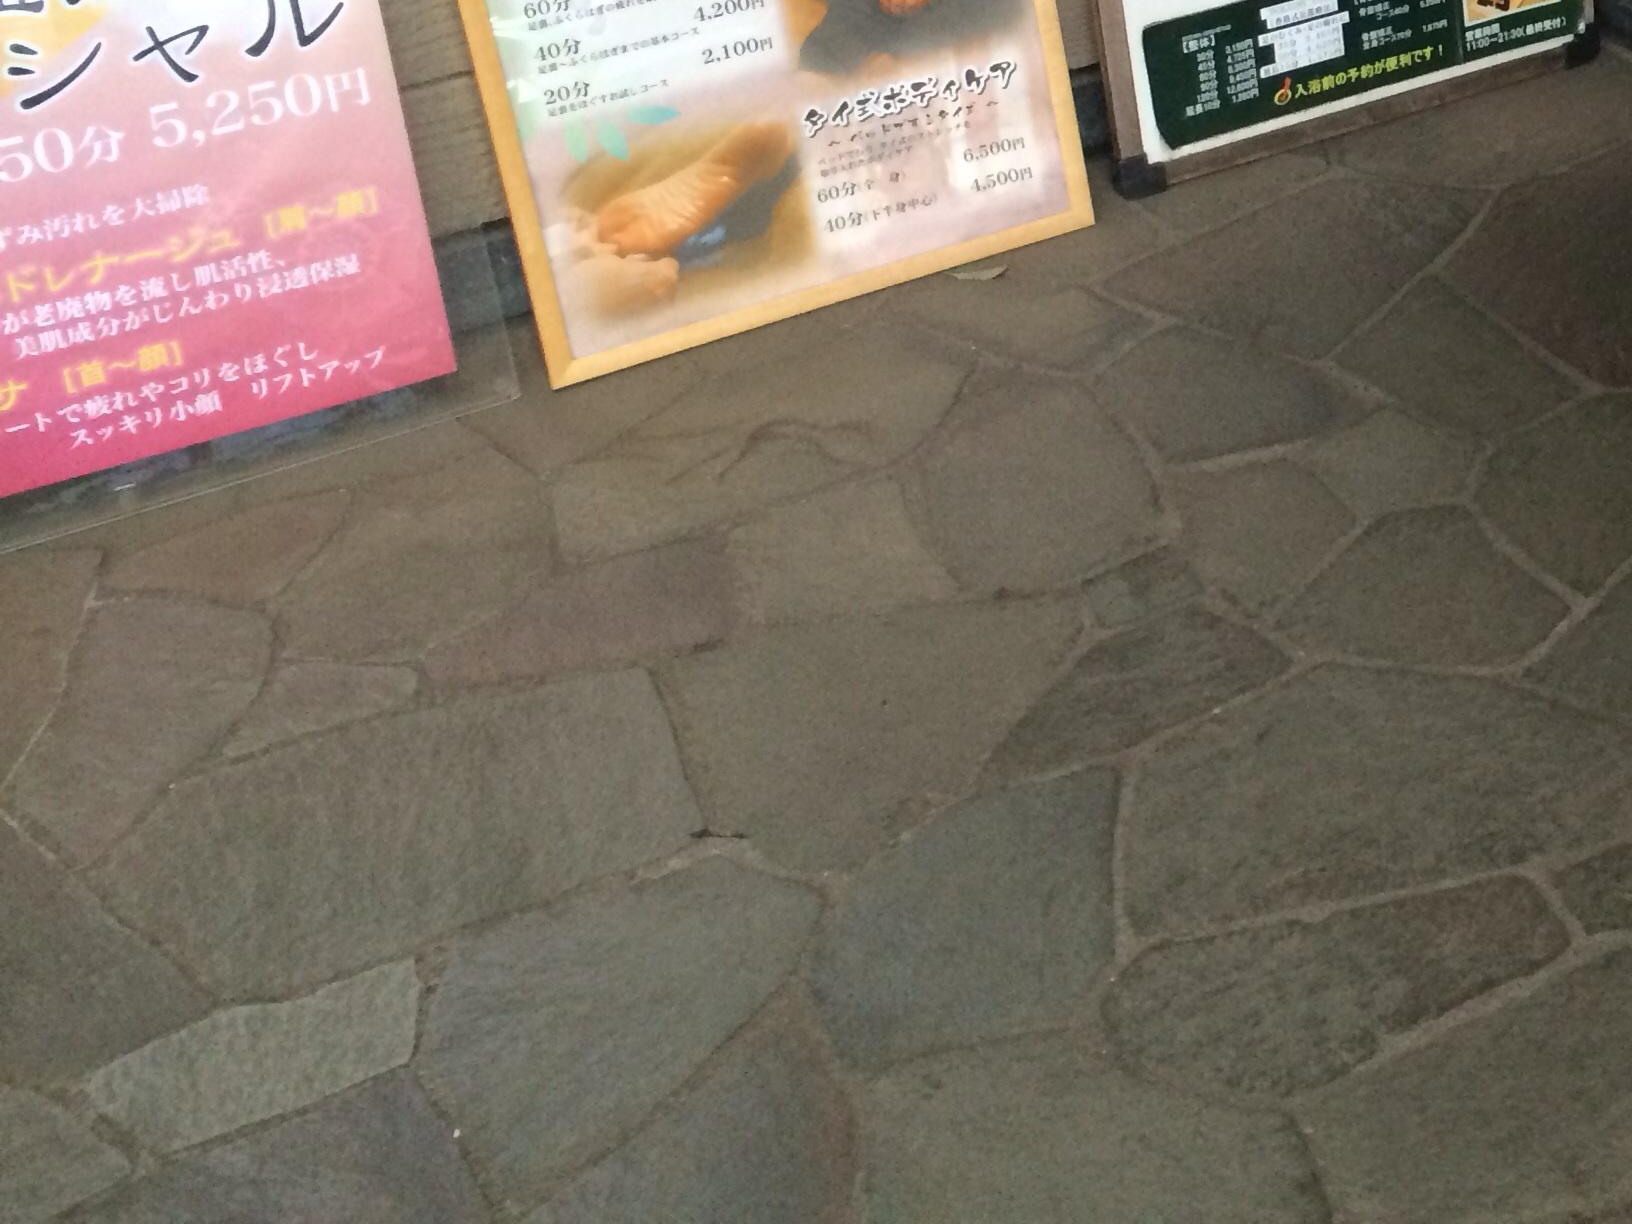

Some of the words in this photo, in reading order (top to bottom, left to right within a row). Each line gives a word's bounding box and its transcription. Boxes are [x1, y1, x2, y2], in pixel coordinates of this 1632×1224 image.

[532, 36, 583, 64] 40分
[149, 66, 370, 149] 5,250円
[543, 80, 592, 107] 20分
